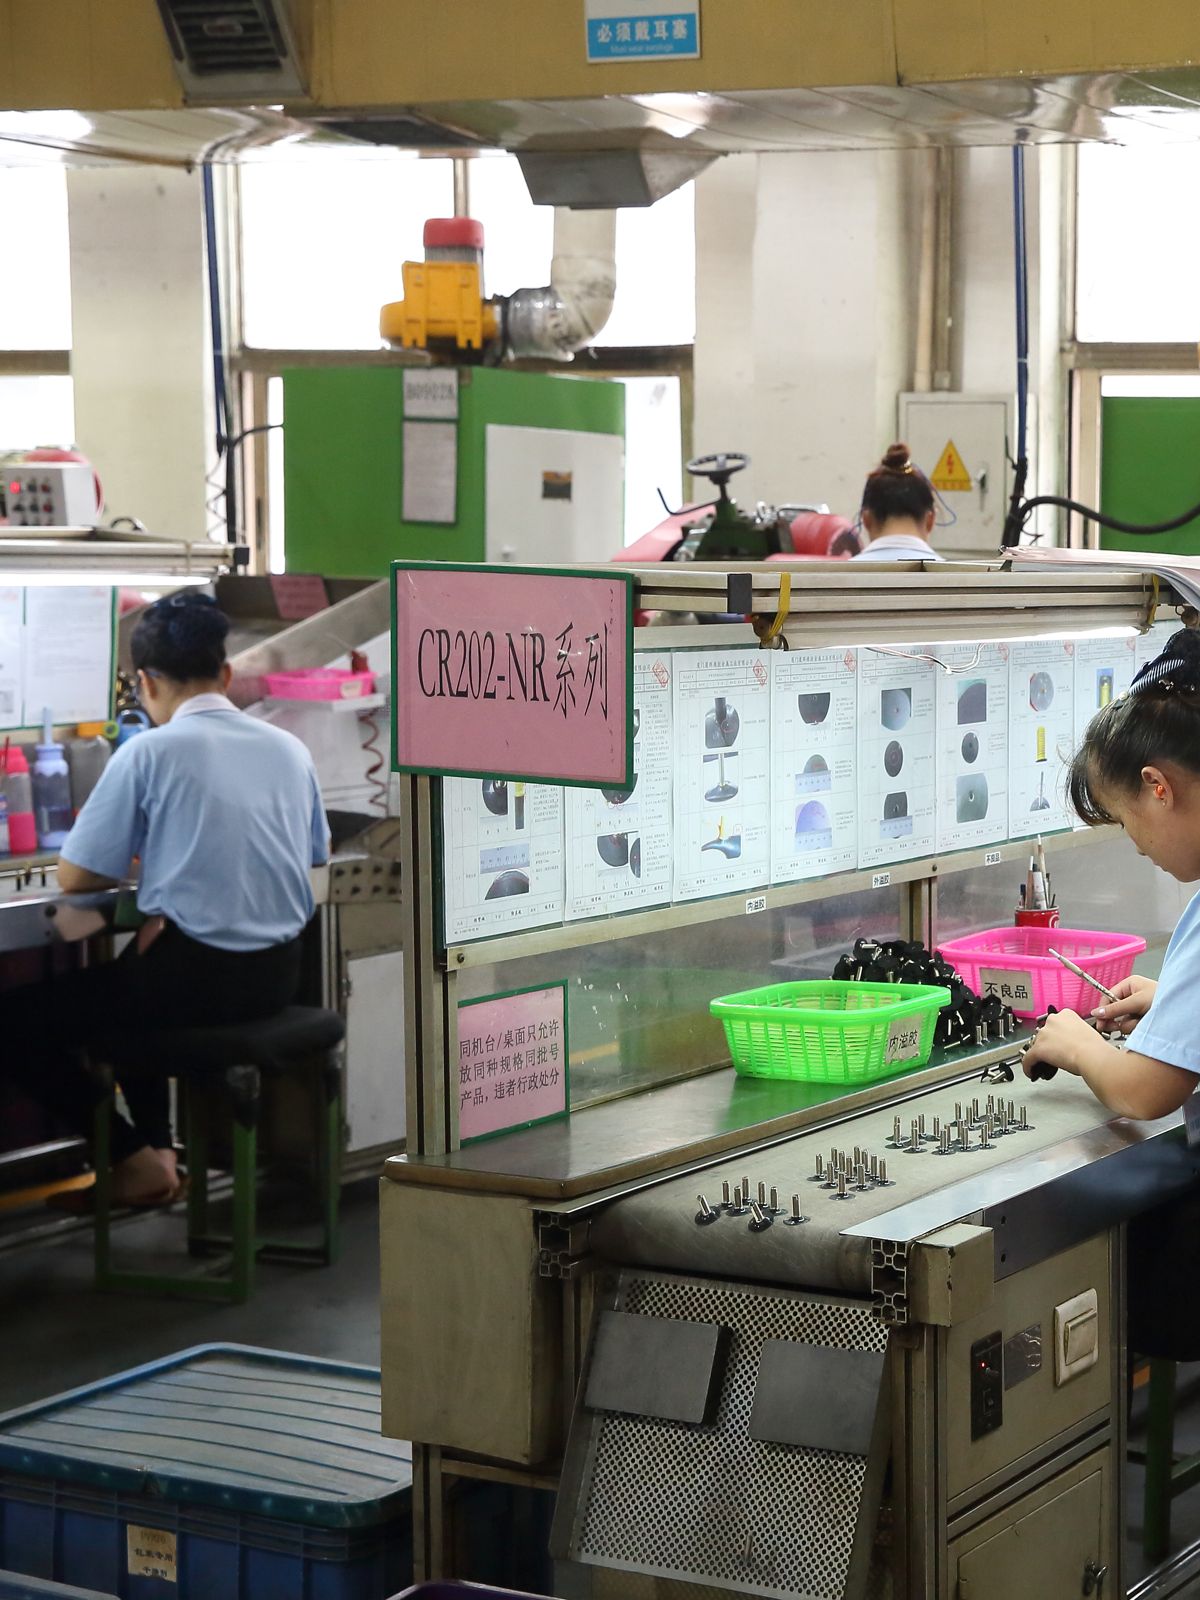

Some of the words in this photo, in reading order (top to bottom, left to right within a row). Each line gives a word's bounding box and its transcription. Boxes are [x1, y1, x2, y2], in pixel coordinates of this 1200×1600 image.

[597, 19, 687, 43] 必须戴耳塞
[418, 622, 608, 720] CR202-NR系列
[984, 982, 1028, 999] 不良品
[459, 1019, 559, 1060] 同机台/桌面只允许
[459, 1042, 559, 1085] 放同种规格同批号
